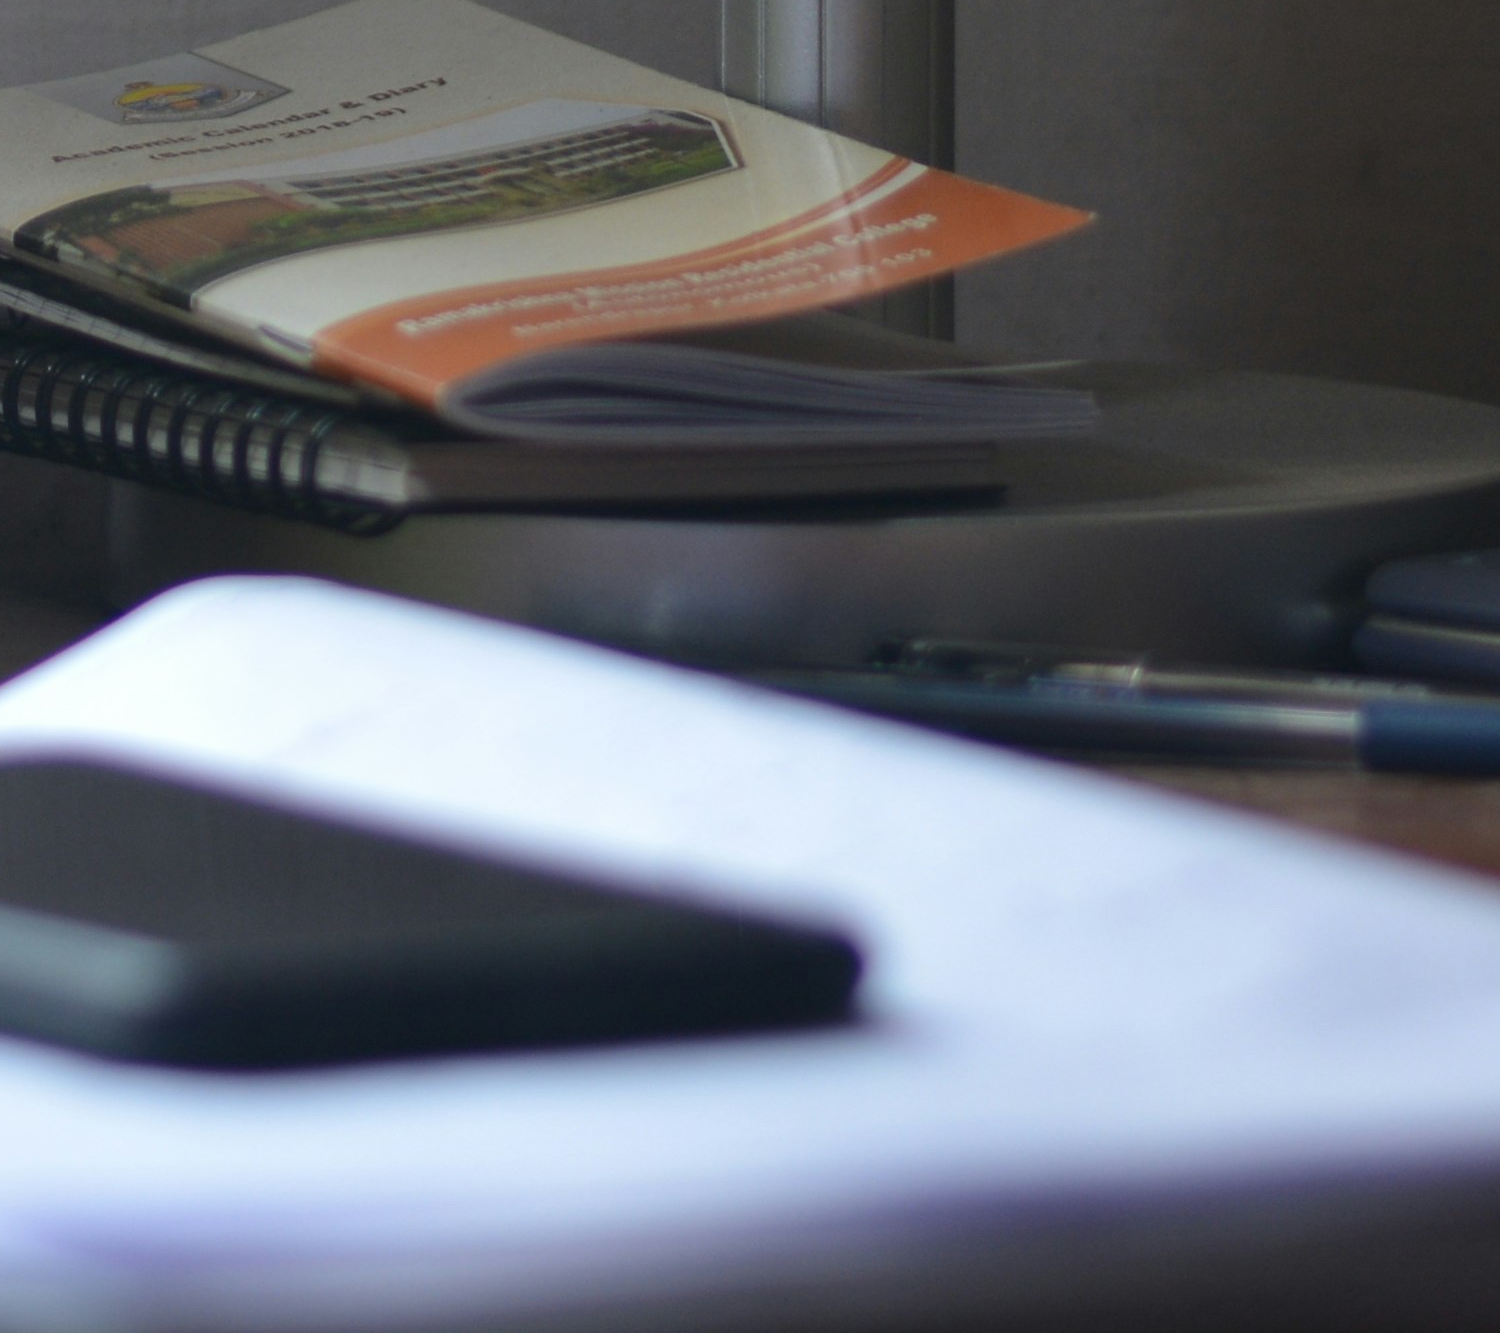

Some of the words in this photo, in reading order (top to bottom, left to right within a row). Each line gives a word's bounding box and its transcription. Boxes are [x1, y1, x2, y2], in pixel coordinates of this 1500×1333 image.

[51, 136, 197, 163] Academic
[201, 108, 331, 137] Calendar
[367, 76, 447, 102] Diary
[680, 241, 837, 283] Residential
[832, 213, 938, 246] College
